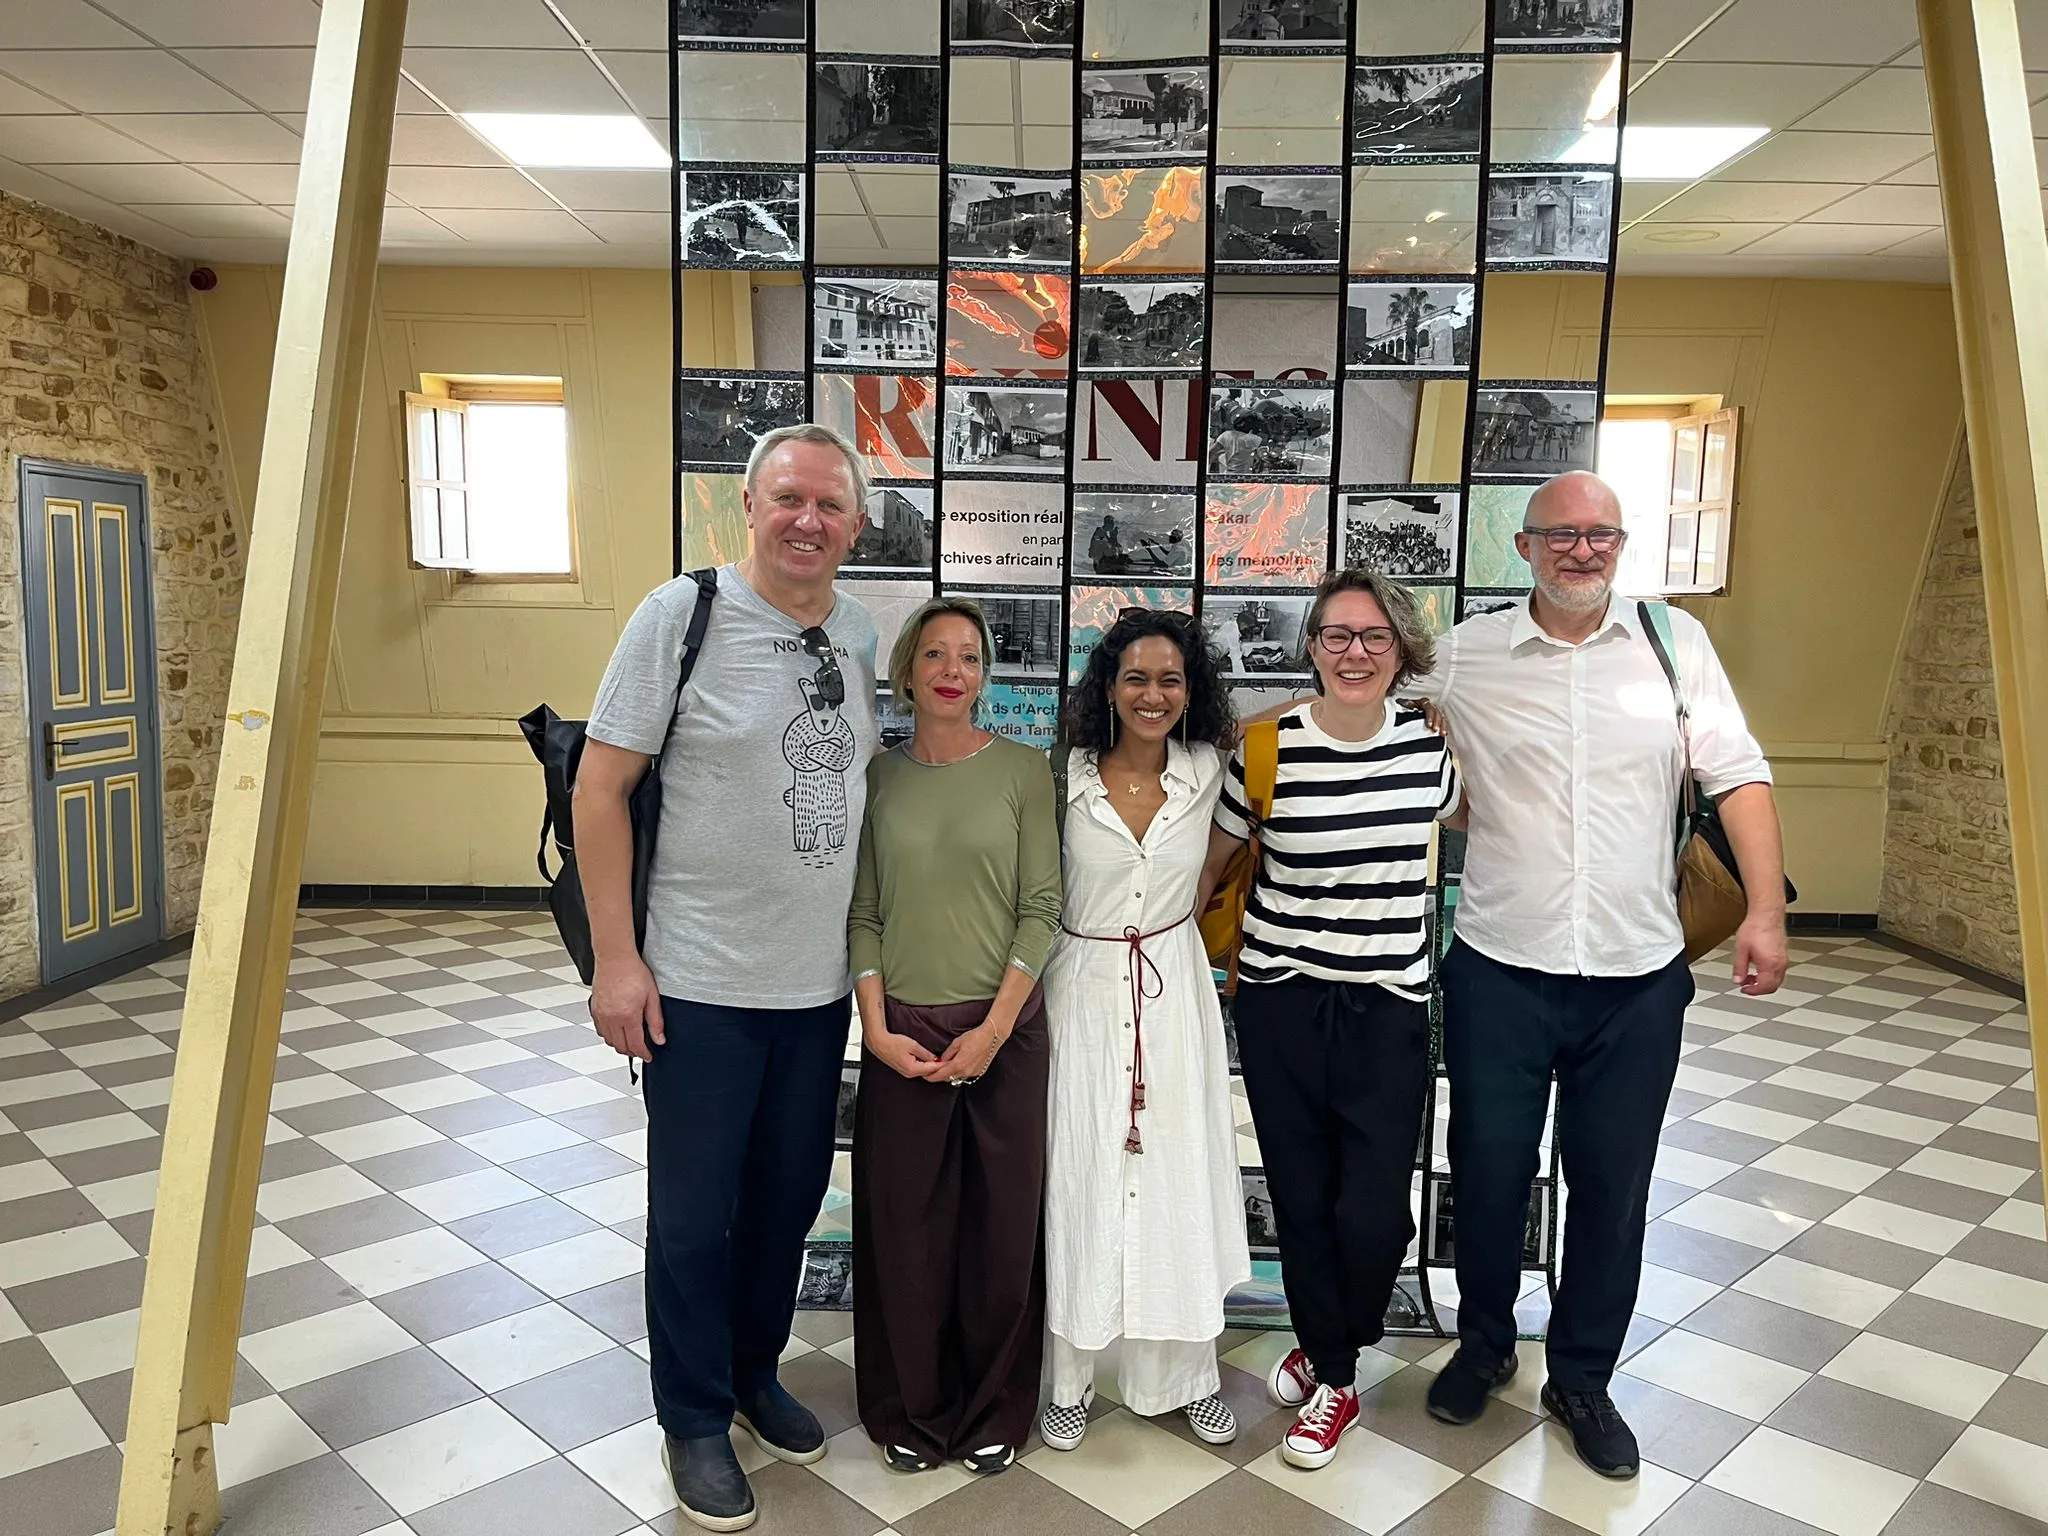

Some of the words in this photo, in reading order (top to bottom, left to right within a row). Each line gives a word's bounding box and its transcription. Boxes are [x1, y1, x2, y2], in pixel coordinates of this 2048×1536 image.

[950, 510, 1030, 524] exposition
[1206, 511, 1251, 524] akar
[1022, 536, 1038, 545] en
[995, 553, 1053, 566] africain
[773, 640, 798, 654] NO
